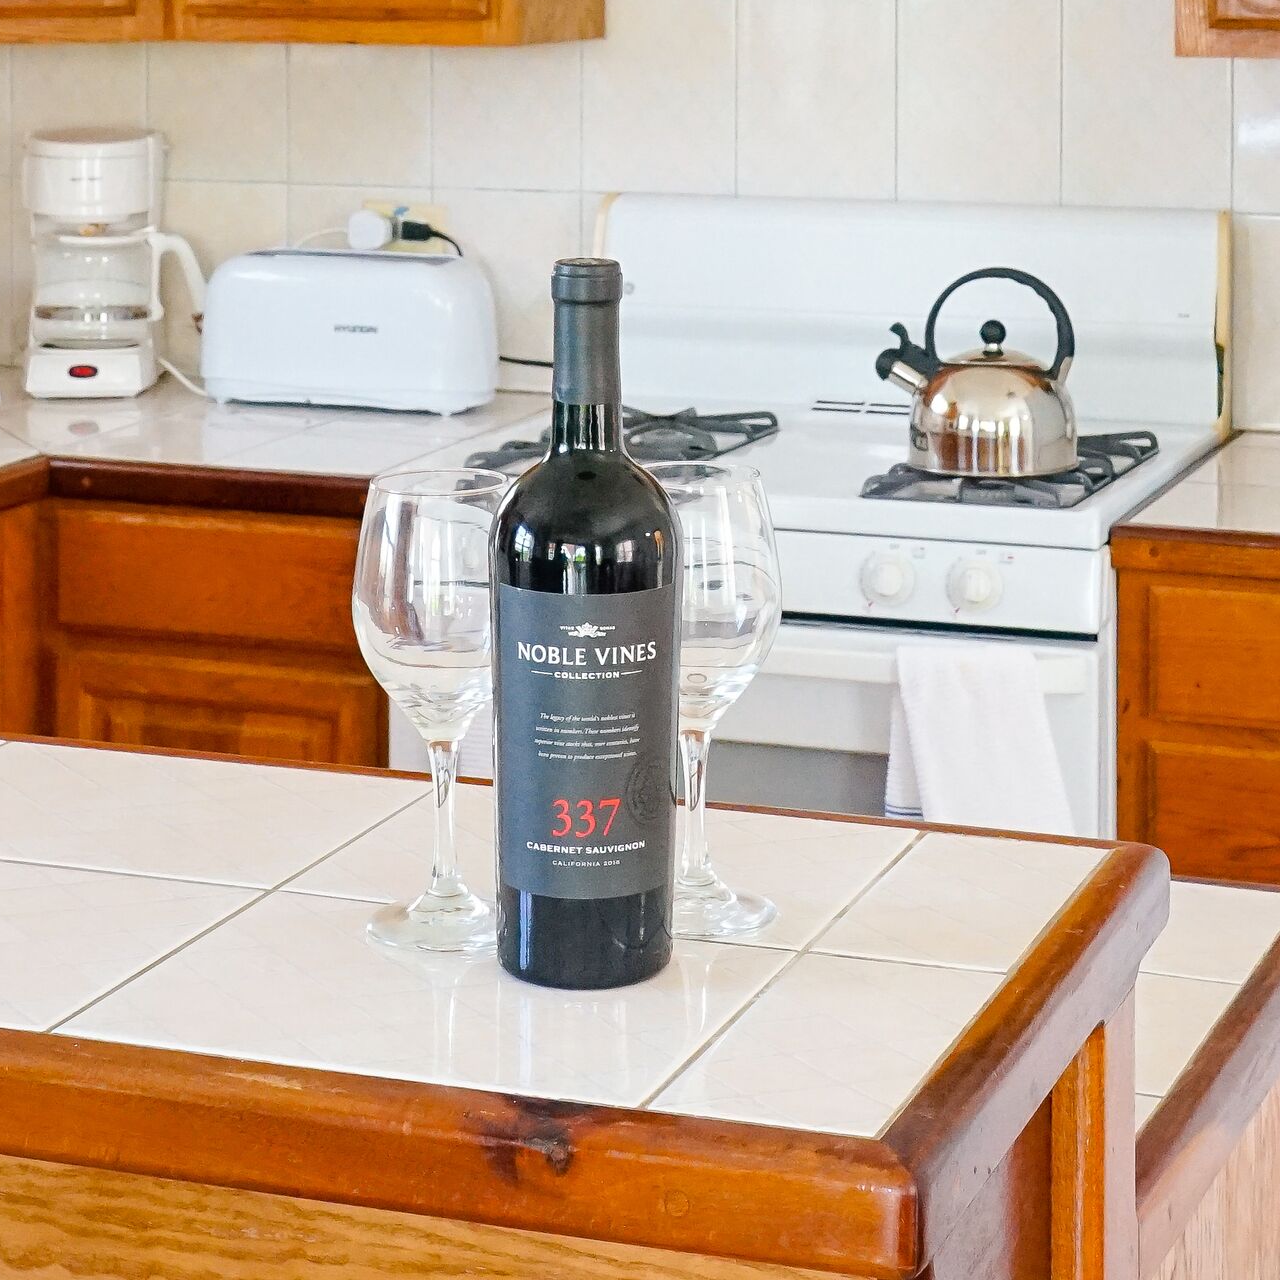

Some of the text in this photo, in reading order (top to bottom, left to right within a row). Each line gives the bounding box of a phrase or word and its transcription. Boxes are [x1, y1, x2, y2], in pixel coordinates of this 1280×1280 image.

[517, 641, 657, 666] NOBLE VINES
[554, 671, 620, 680] COLLECTION
[552, 798, 621, 838] 337
[526, 840, 646, 854] CABERNET SAUVIGNON
